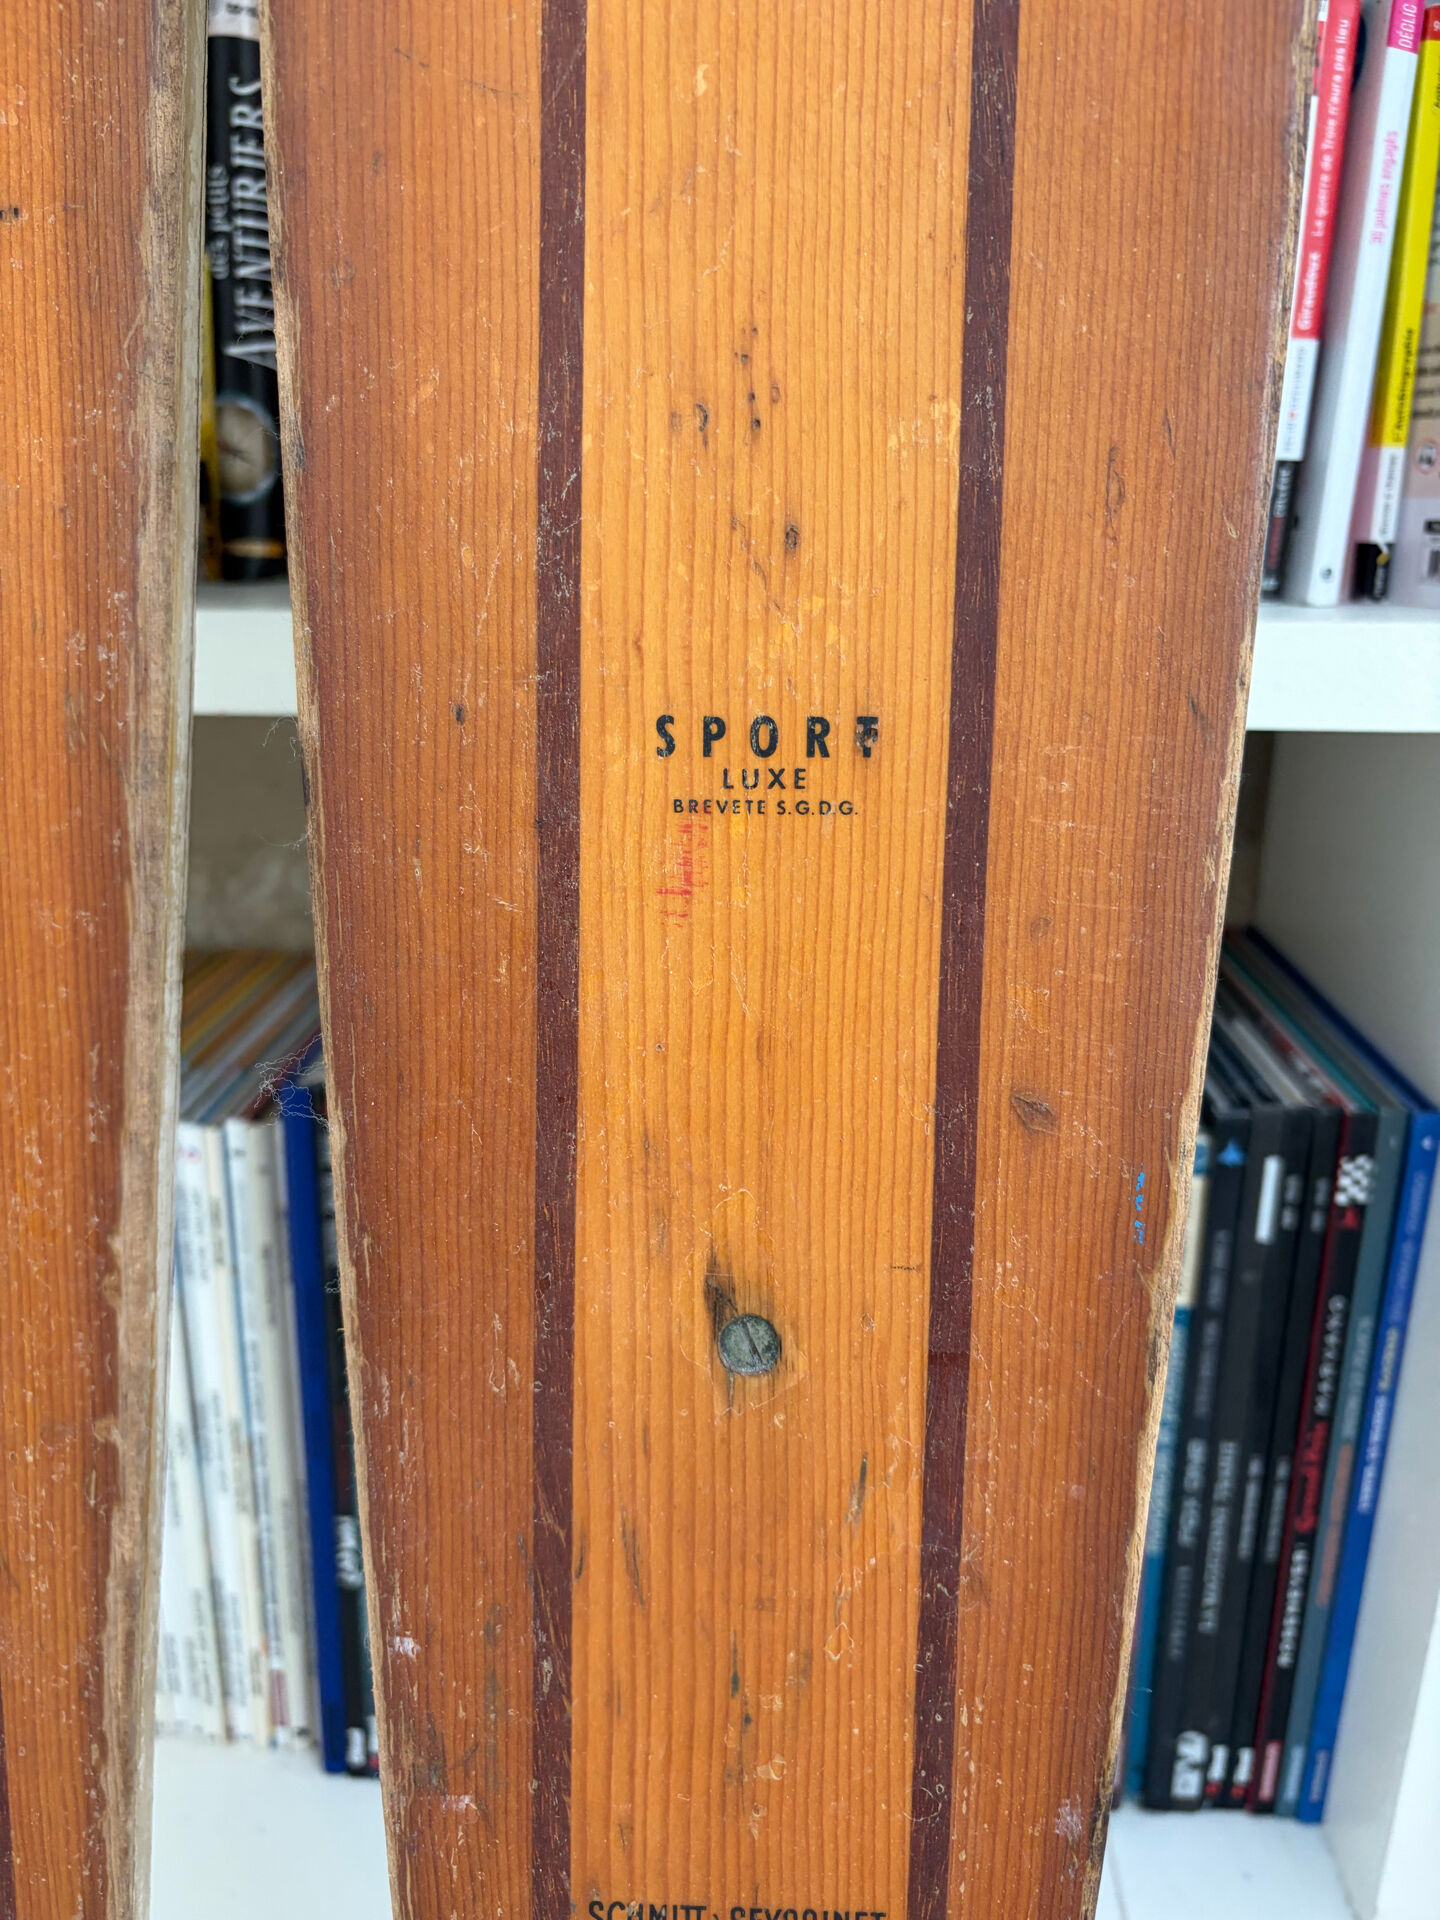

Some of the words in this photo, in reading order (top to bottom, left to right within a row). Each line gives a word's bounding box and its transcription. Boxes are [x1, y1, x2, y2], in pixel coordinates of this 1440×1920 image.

[1335, 19, 1350, 43] lieu
[1396, 3, 1417, 48] DÉCLIC
[1333, 45, 1348, 73] pas
[655, 714, 879, 758] SPORT
[722, 767, 807, 790] LUXE
[673, 799, 766, 815] BREVETE
